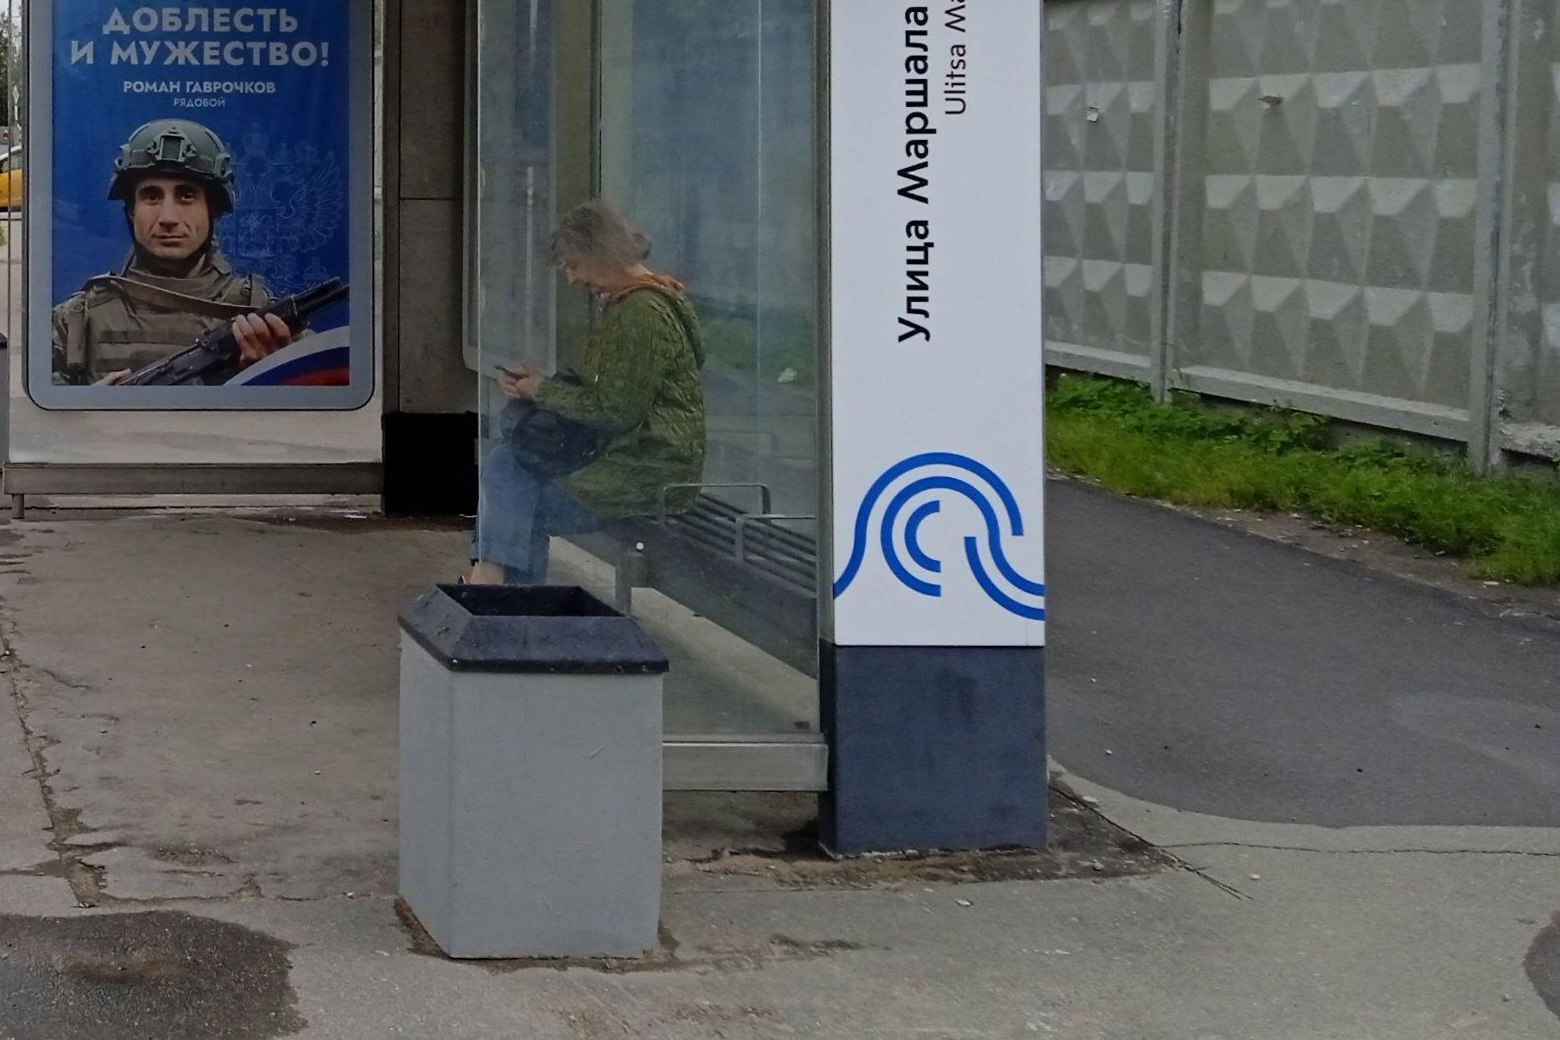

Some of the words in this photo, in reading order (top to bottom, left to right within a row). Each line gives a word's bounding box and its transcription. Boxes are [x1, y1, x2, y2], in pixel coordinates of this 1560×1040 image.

[102, 7, 299, 35] ДОБЛЕСТЬ
[70, 40, 94, 65] И
[110, 41, 330, 67] МУЖЕСТВО!
[123, 80, 181, 93] РОМАН
[186, 79, 277, 94] ГАВРОЧКОВ
[944, 43, 968, 116] Ulitsa
[173, 96, 226, 108] РЯДОВОЙ
[896, 5, 937, 205] Маршала
[896, 218, 935, 343] Улица
